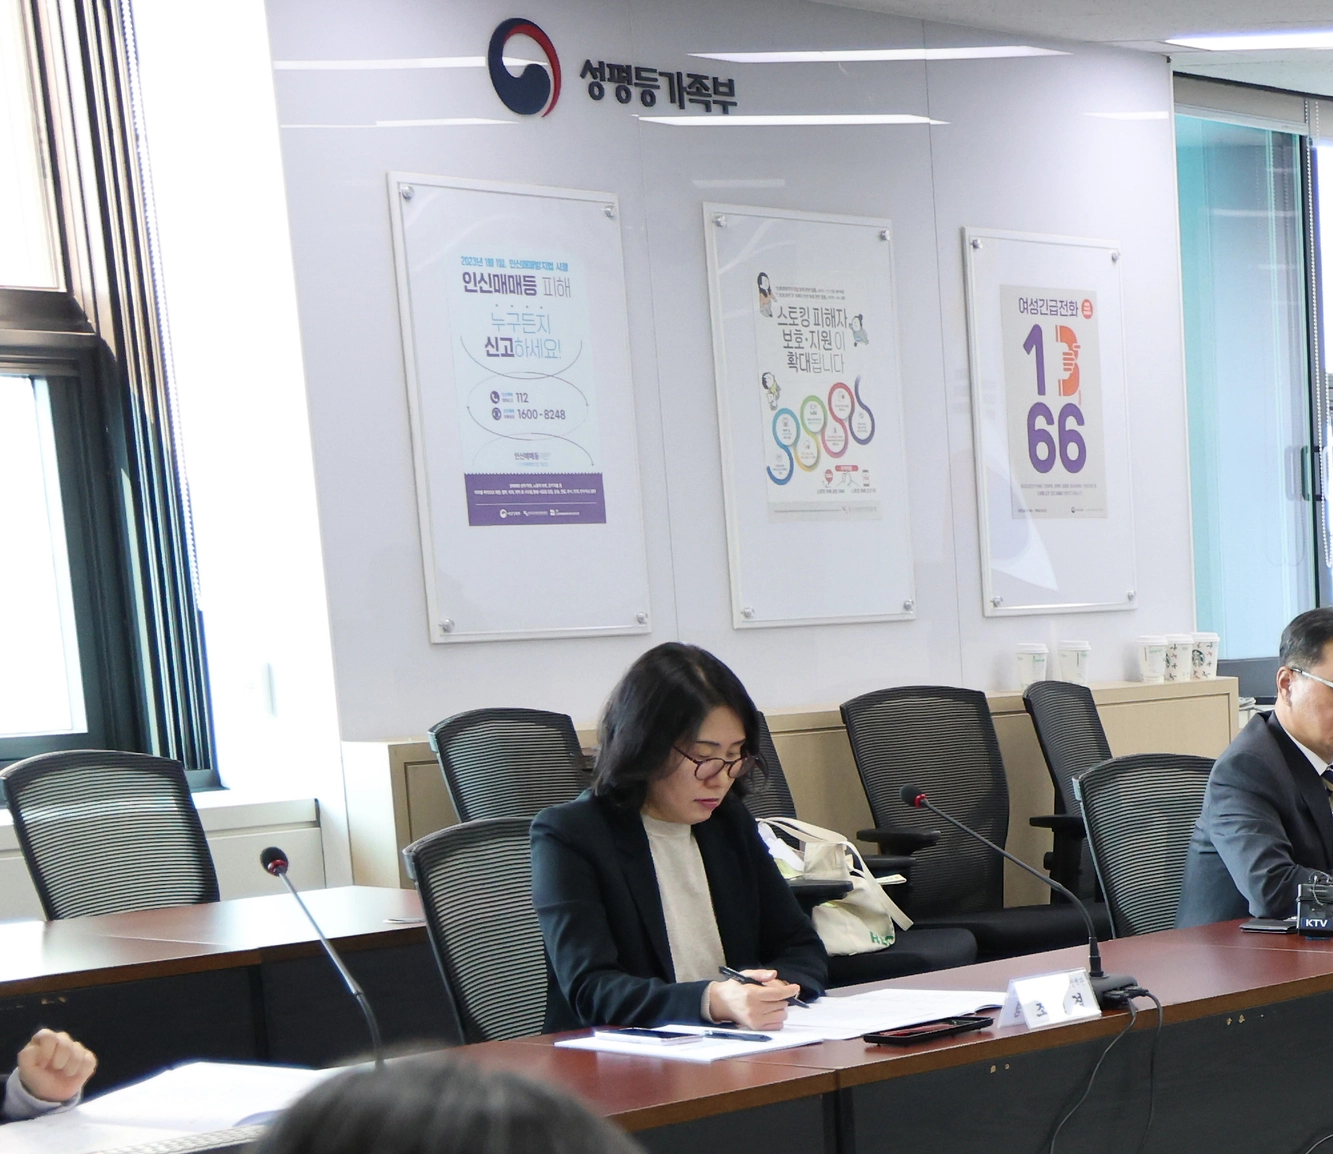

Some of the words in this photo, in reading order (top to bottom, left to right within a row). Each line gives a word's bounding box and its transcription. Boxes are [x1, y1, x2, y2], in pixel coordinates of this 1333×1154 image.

[580, 59, 738, 115] 성평등가족부
[462, 271, 537, 296] 인신매매등
[541, 276, 571, 298] 피해
[777, 306, 810, 328] 스토킹
[812, 307, 848, 329] 피해자
[1018, 297, 1078, 317] 여성긴급전화
[491, 312, 551, 334] 누구든지
[484, 336, 562, 359] 신고하세요!
[787, 351, 845, 373] 확대됩니다
[515, 392, 529, 403] 112
[1027, 402, 1087, 474] 66
[1305, 919, 1328, 928] KTV
